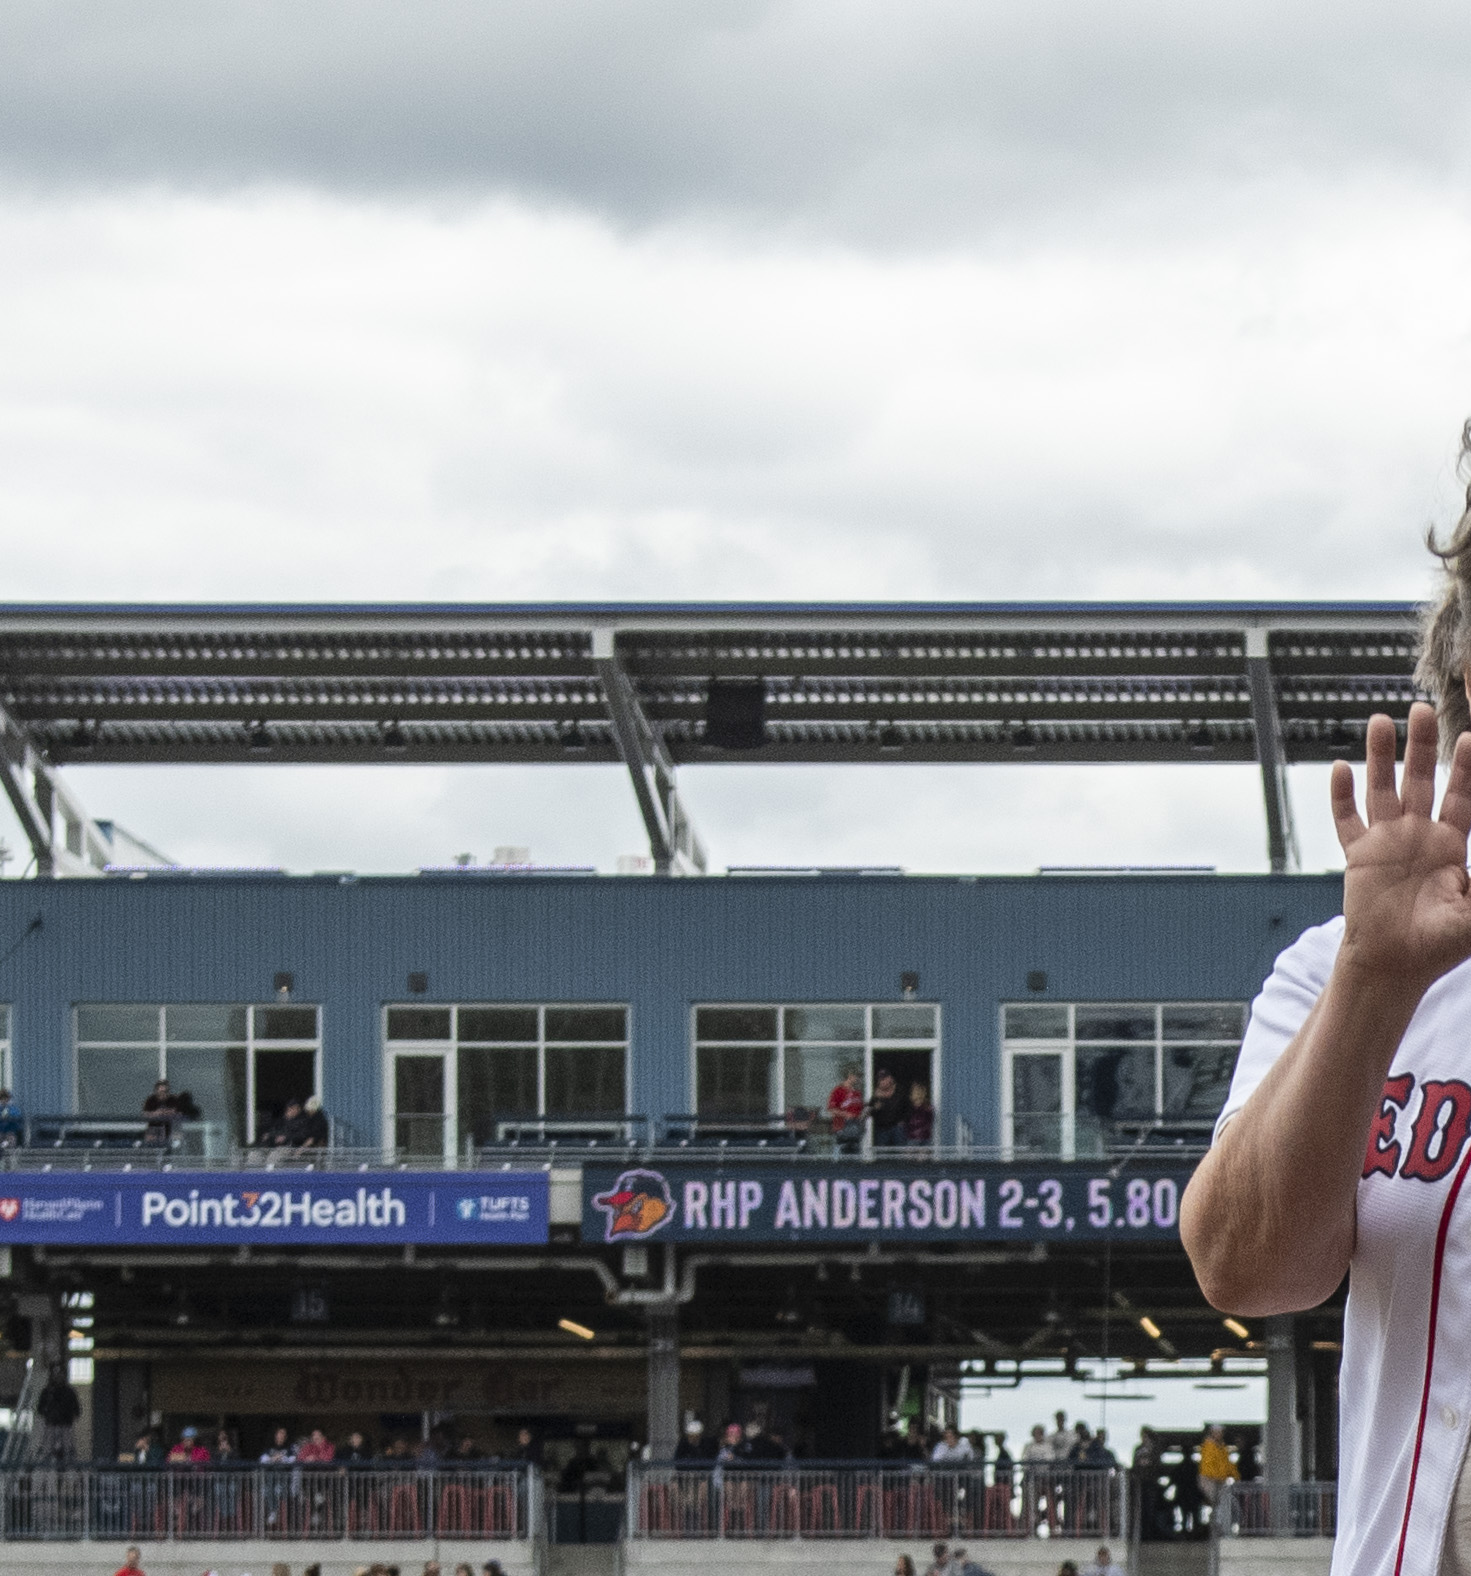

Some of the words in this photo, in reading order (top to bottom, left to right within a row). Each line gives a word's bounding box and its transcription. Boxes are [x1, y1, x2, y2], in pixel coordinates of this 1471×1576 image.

[142, 1187, 405, 1227] Point32Health
[683, 1179, 765, 1230] RHP
[774, 1178, 986, 1230] ANDERSON
[998, 1178, 1076, 1232] 2-3,
[1088, 1177, 1178, 1229] 5.80
